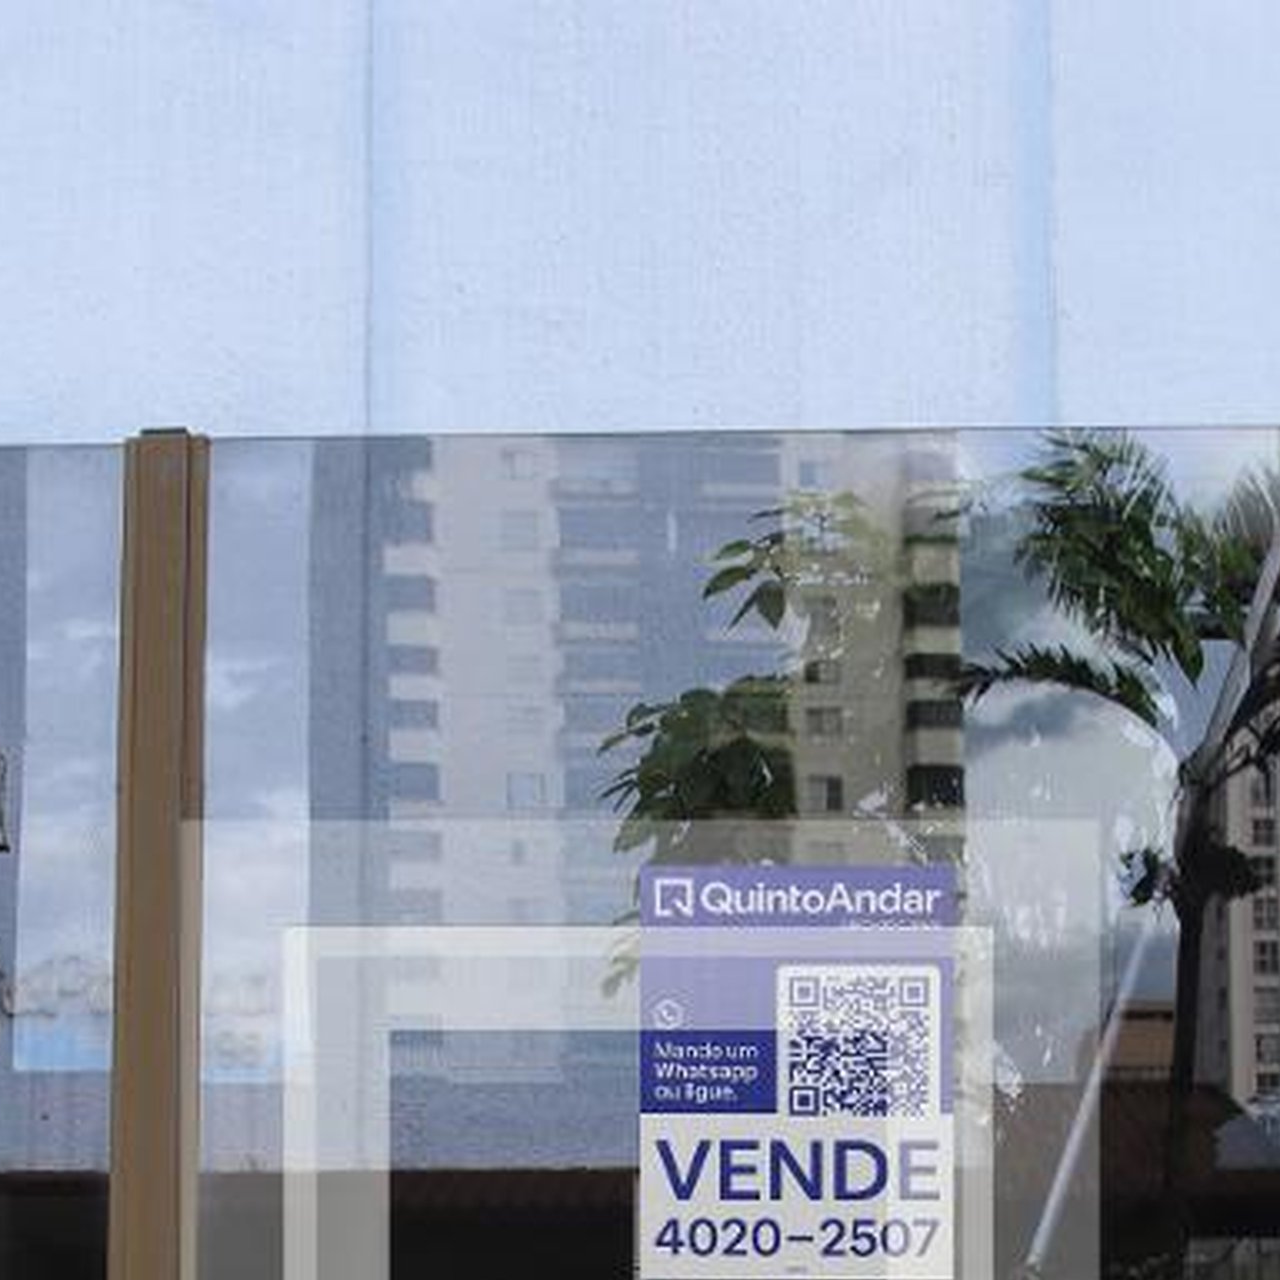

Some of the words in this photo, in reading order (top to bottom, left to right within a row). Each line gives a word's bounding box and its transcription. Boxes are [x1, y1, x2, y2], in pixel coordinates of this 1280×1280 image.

[701, 881, 941, 917] QuintoAndar
[656, 1140, 940, 1201] VENDE
[655, 1218, 940, 1258] 4020-2507
